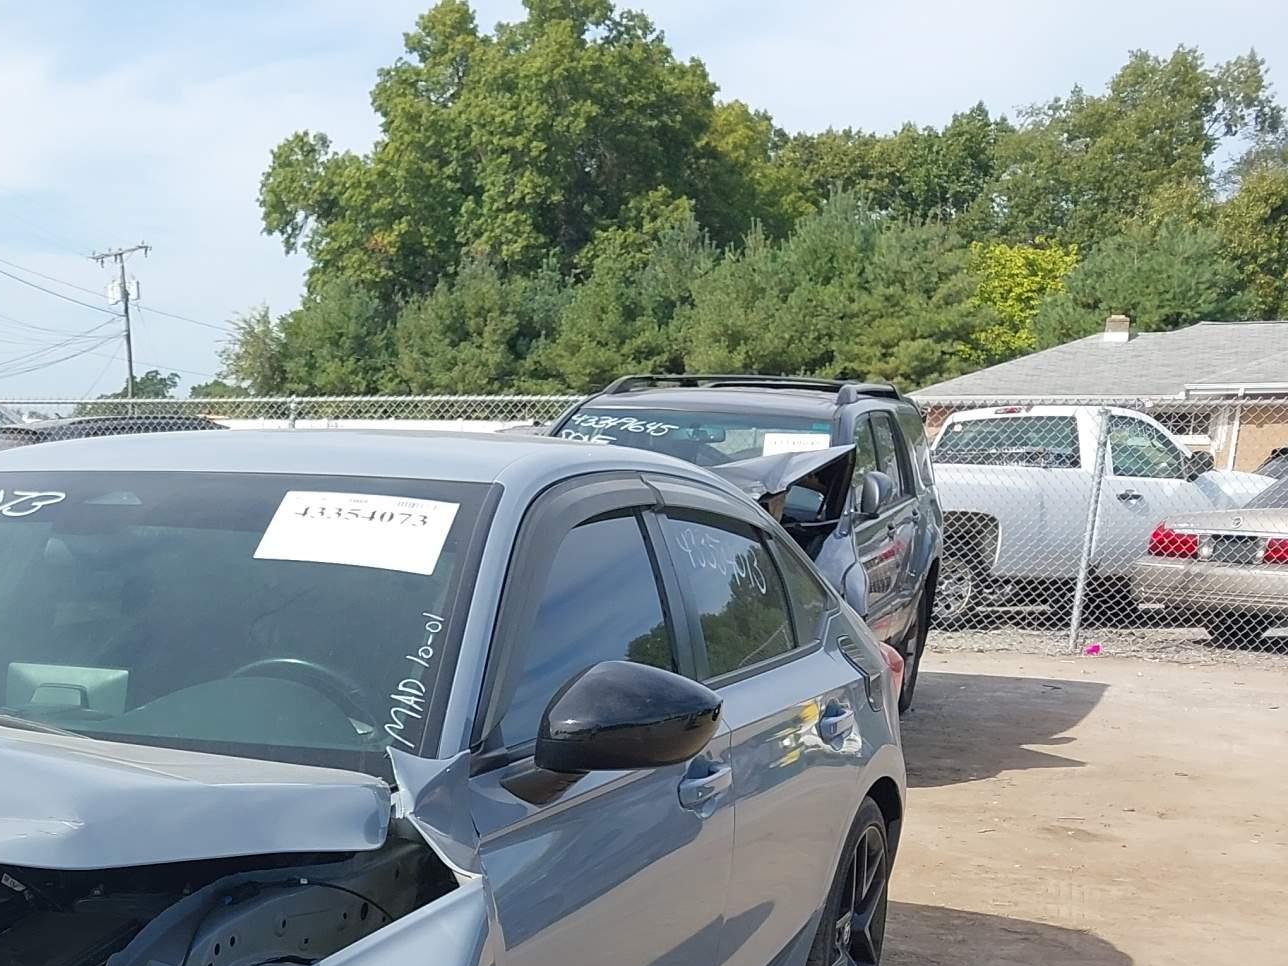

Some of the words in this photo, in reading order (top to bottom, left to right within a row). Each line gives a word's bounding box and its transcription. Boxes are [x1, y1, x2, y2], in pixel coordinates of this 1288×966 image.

[295, 505, 429, 527] 43354073
[384, 678, 426, 749] MAD
[405, 612, 445, 668] 10-01
